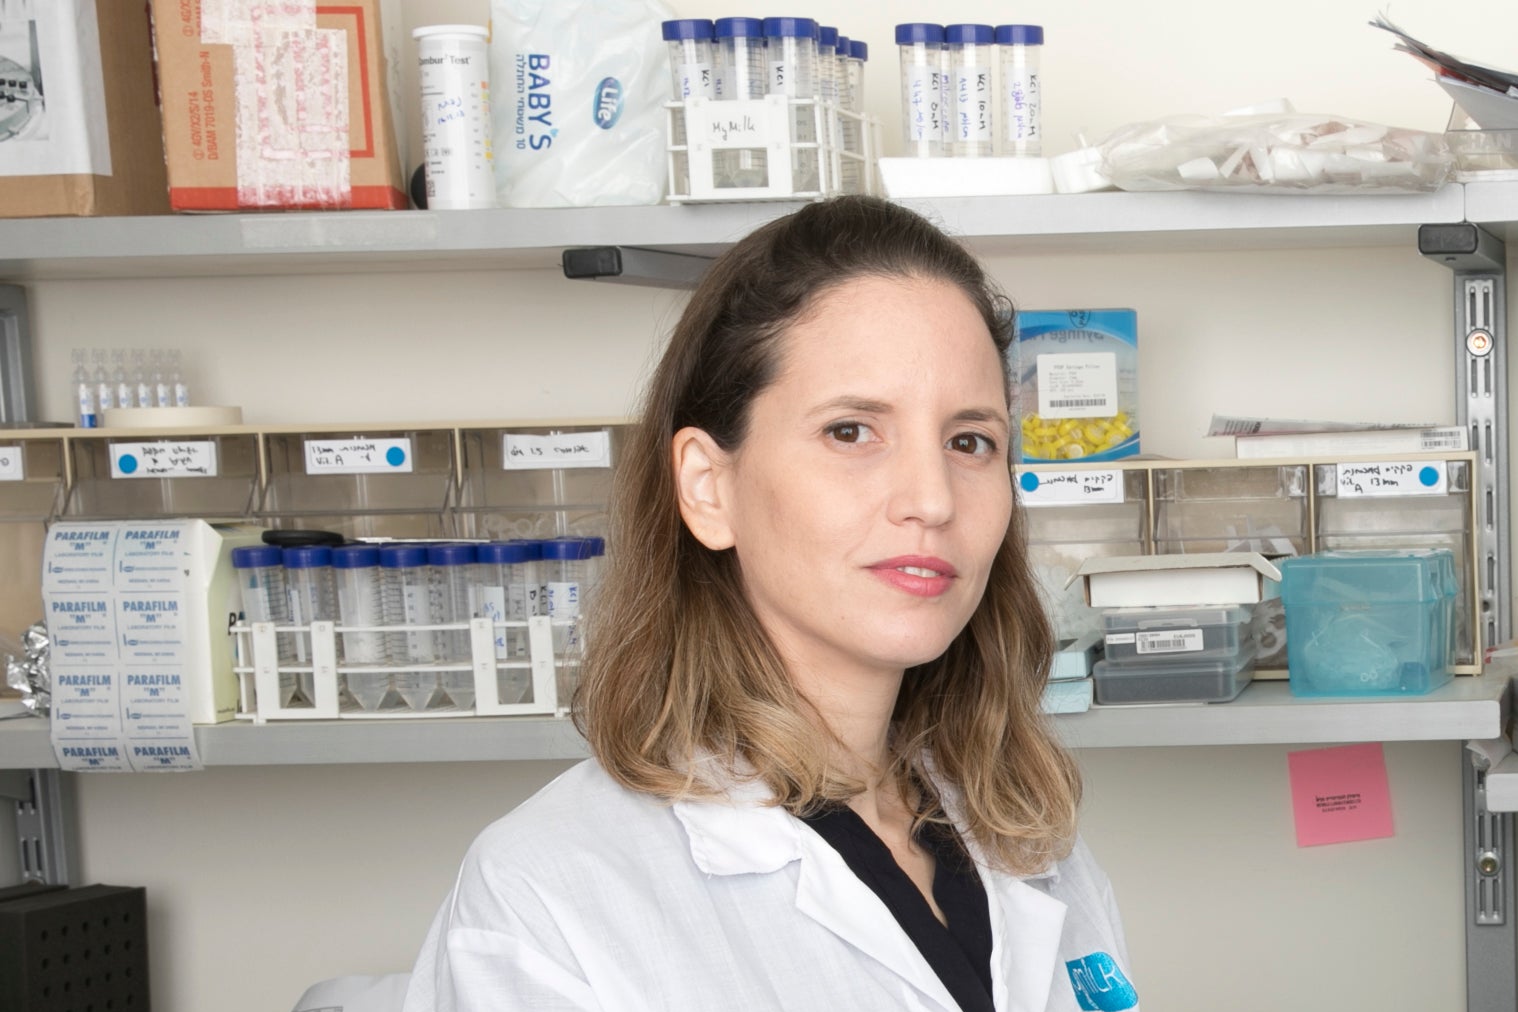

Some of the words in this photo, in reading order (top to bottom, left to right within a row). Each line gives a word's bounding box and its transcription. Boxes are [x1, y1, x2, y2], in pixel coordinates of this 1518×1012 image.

[527, 54, 553, 150] BABY'S
[598, 87, 619, 122] Life
[55, 531, 110, 541] PARAFILM
[125, 530, 180, 540] PARAFILM
[52, 601, 107, 613] PARAFILM
[123, 600, 178, 612] PARAFILM
[58, 674, 112, 686] PARAFILM
[127, 674, 181, 686] PARAFILM
[63, 747, 119, 757] PARAFILM
[134, 746, 190, 756] PARAFILM
